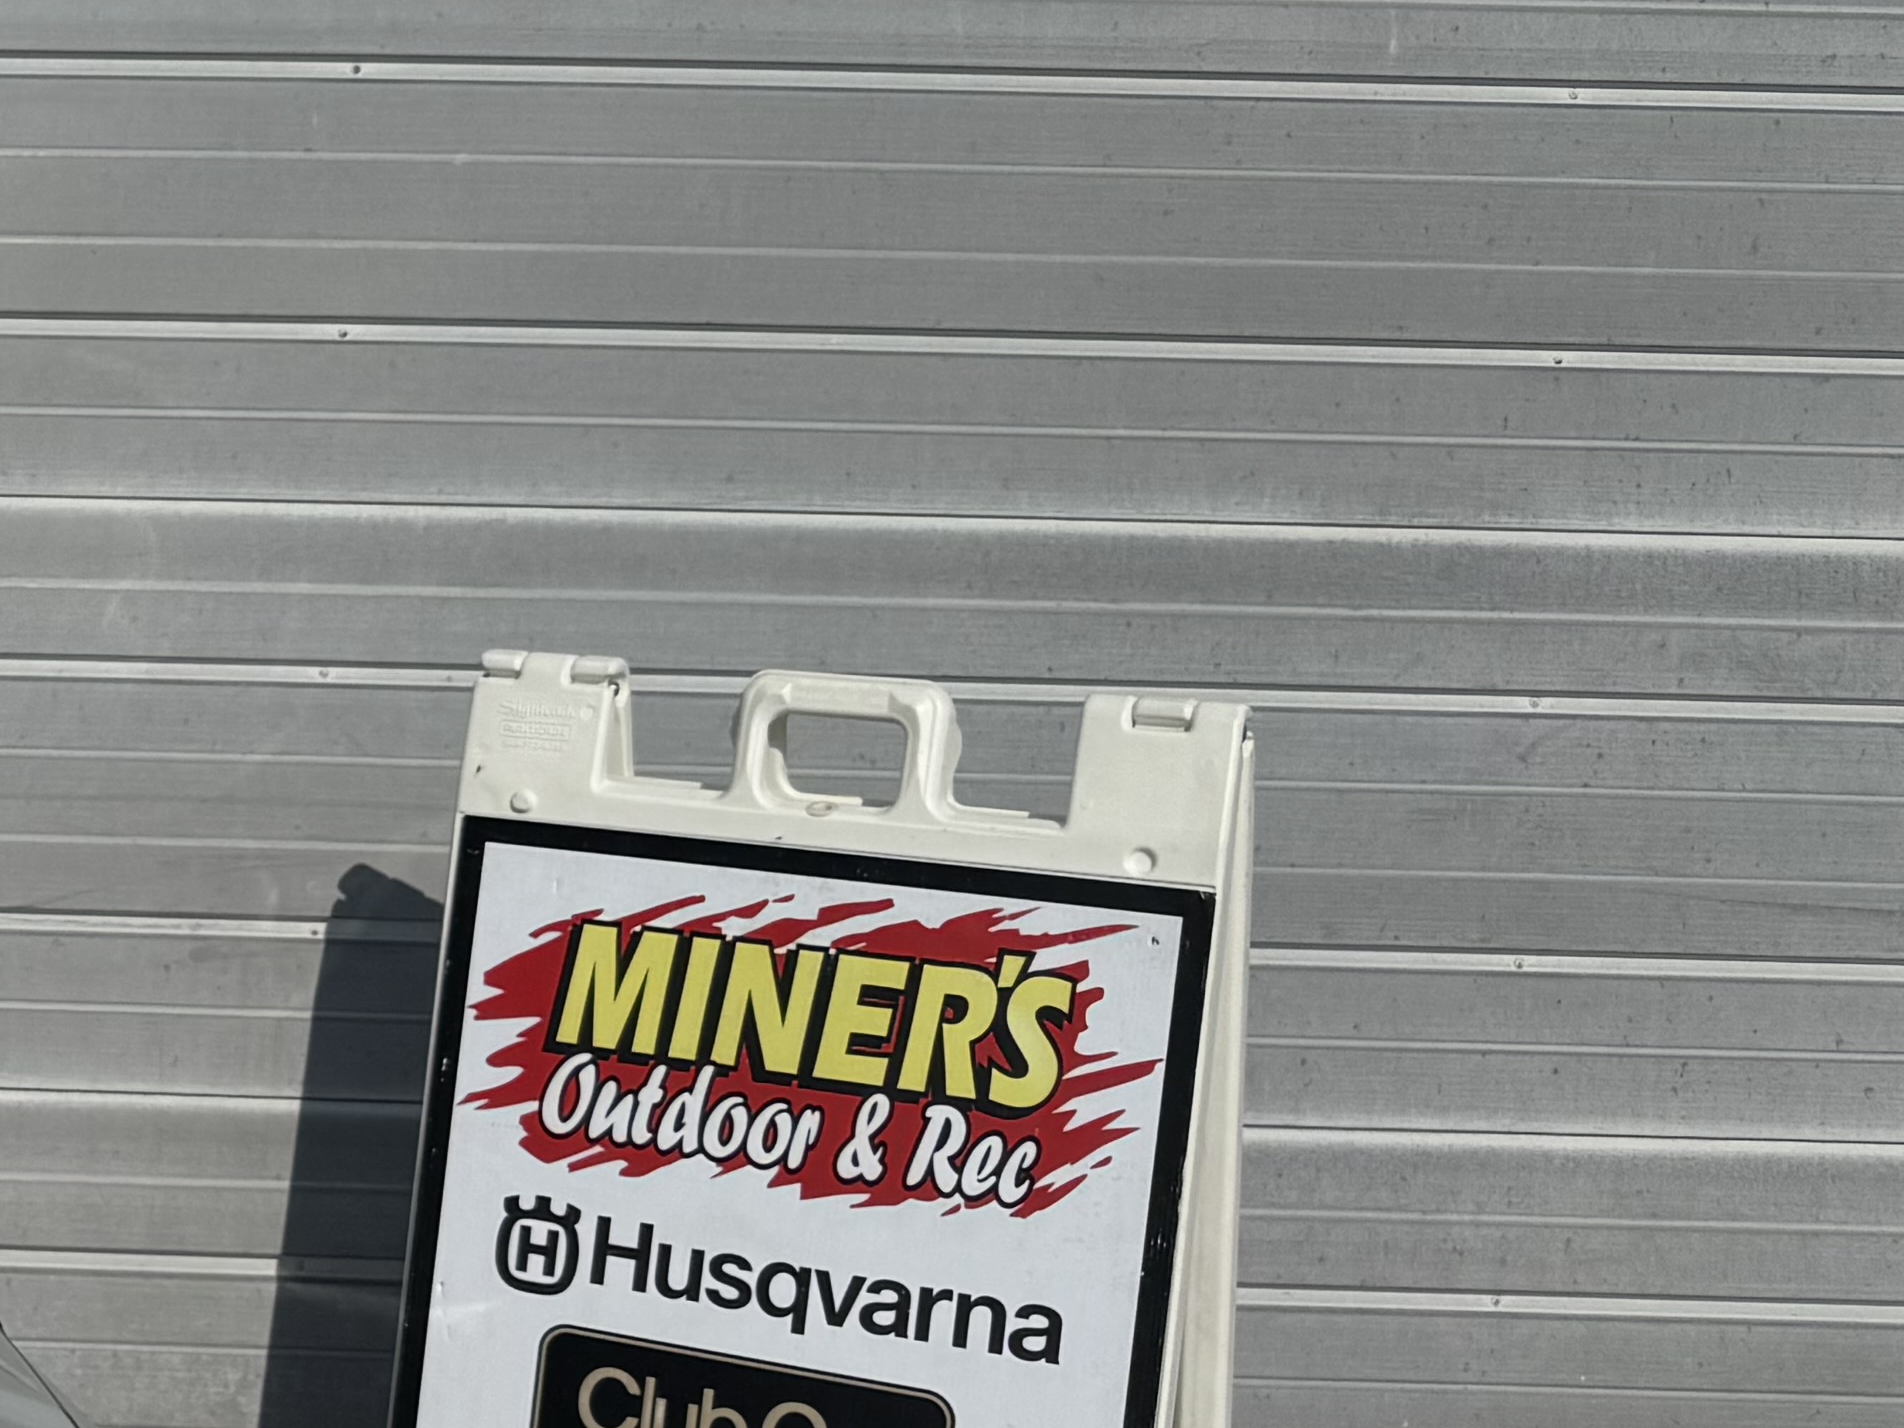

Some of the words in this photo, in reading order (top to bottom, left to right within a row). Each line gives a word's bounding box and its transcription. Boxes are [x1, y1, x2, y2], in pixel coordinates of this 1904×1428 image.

[548, 920, 1075, 1112] MINER'S
[542, 1052, 823, 1170] Outdoor
[836, 1093, 890, 1181] &
[907, 1104, 1040, 1205] Rec
[589, 1215, 1063, 1365] Husqvarna
